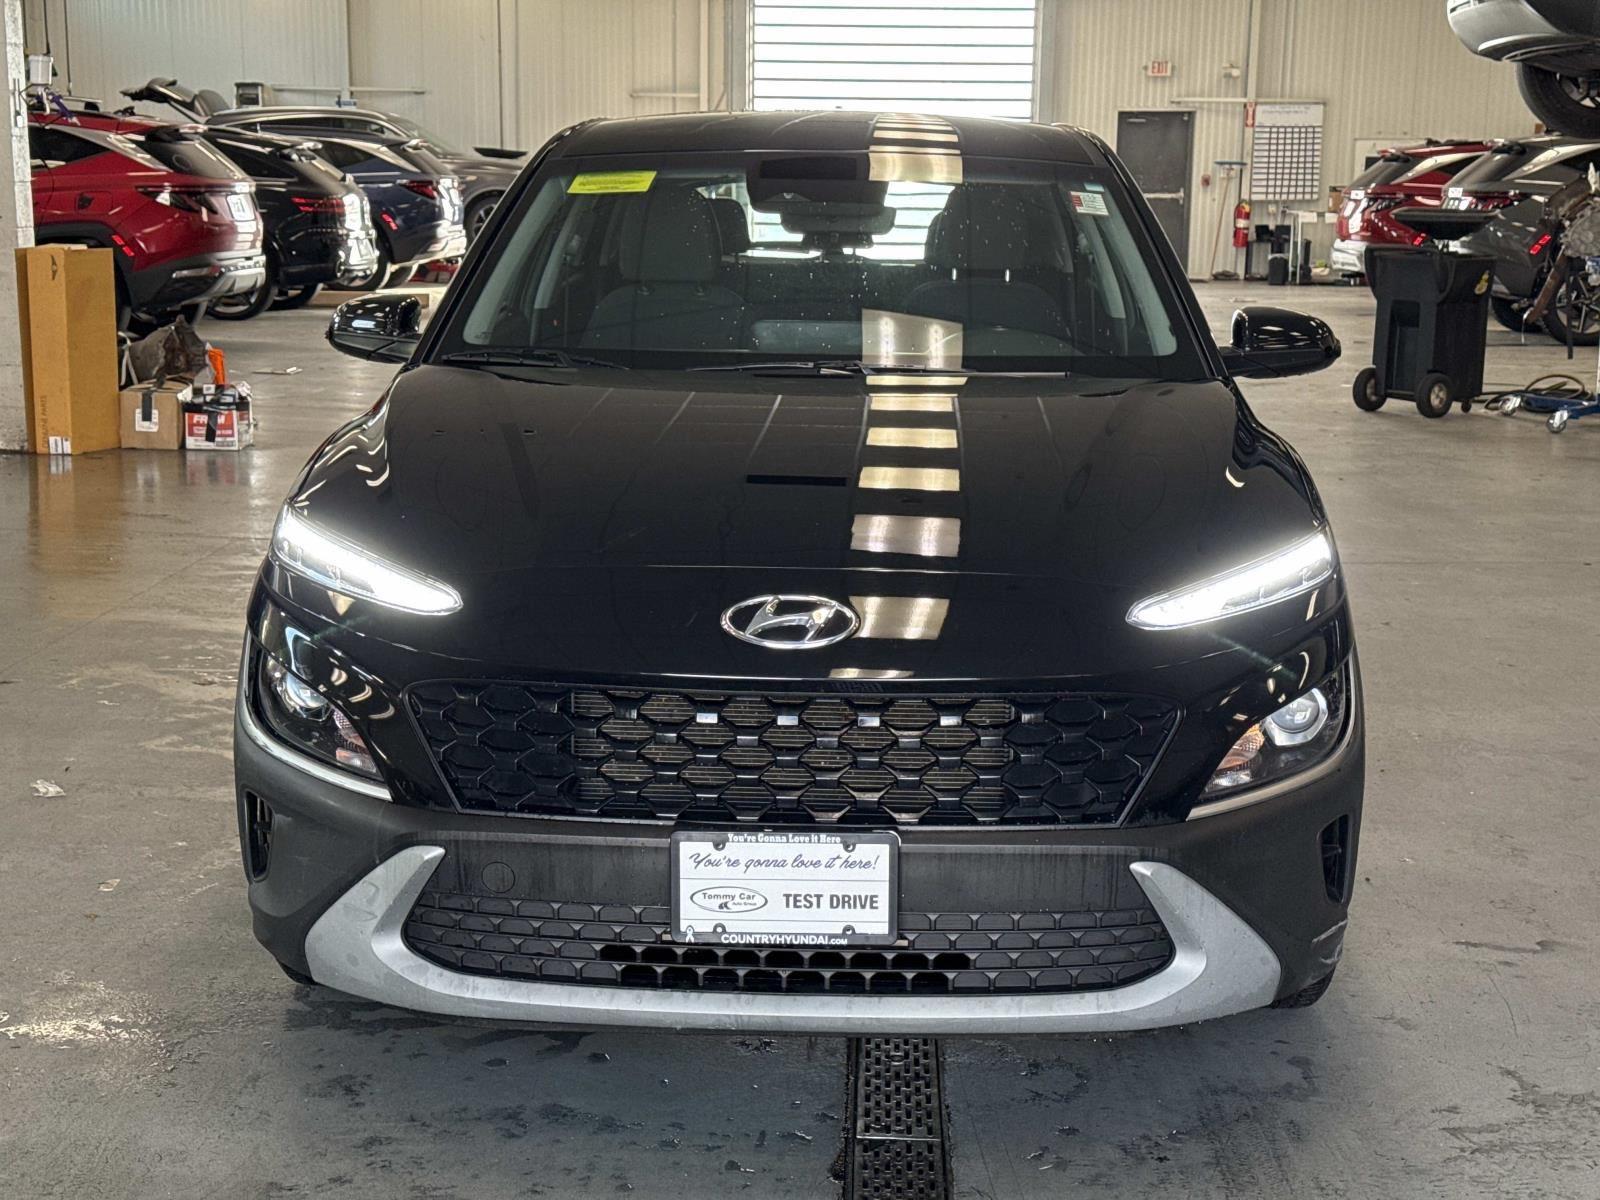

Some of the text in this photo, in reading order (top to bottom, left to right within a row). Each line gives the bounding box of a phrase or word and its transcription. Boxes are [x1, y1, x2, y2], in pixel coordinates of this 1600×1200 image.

[1152, 61, 1168, 74] EXIT
[193, 414, 226, 424] FRM
[727, 833, 841, 844] You're Gonna Love it Here
[689, 852, 880, 874] You're gonna love it here!
[702, 892, 756, 902] Tommy Car
[783, 893, 879, 910] TEST DRIVE
